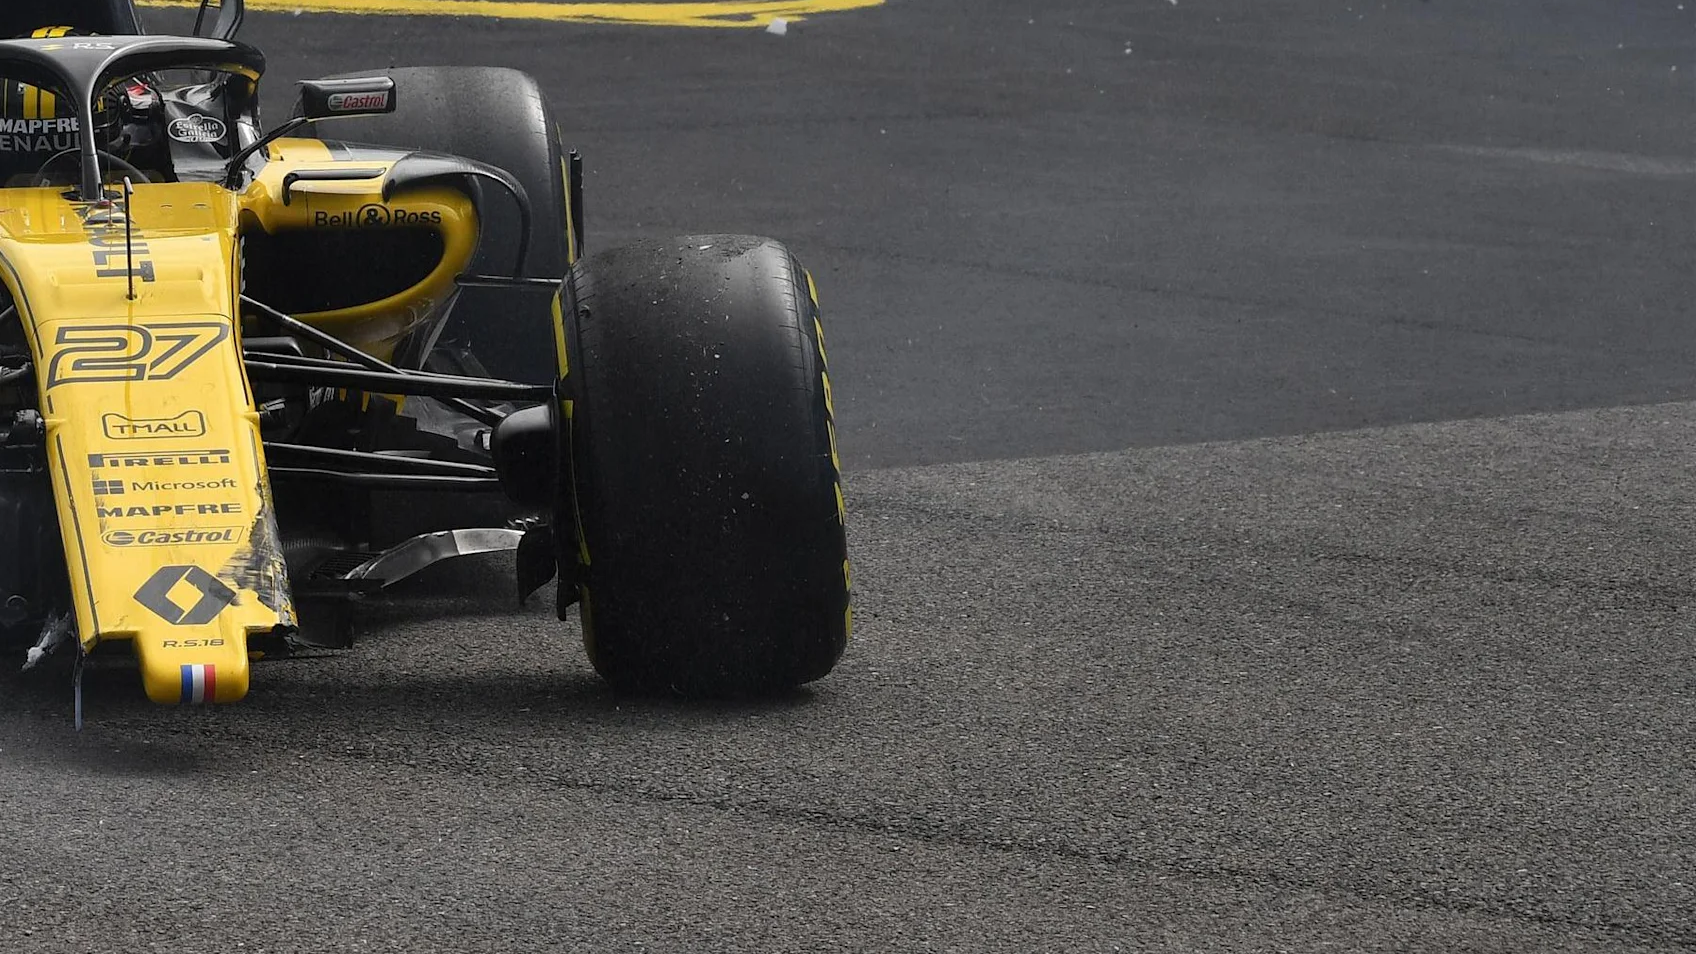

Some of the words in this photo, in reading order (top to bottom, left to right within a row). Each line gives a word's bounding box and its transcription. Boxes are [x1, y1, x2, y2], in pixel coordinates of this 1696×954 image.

[342, 94, 386, 109] Castrol
[175, 121, 219, 132] Estrella
[315, 210, 353, 227] Bell
[360, 206, 387, 227] &
[394, 209, 442, 225] Ross
[46, 321, 230, 390] 27
[112, 423, 197, 435] TMALL
[87, 449, 231, 468] PIRELLI
[132, 477, 237, 491] Microsoft
[97, 503, 242, 518] MAPFRE
[137, 528, 233, 545] Castrol
[162, 638, 225, 648] R.S.18
